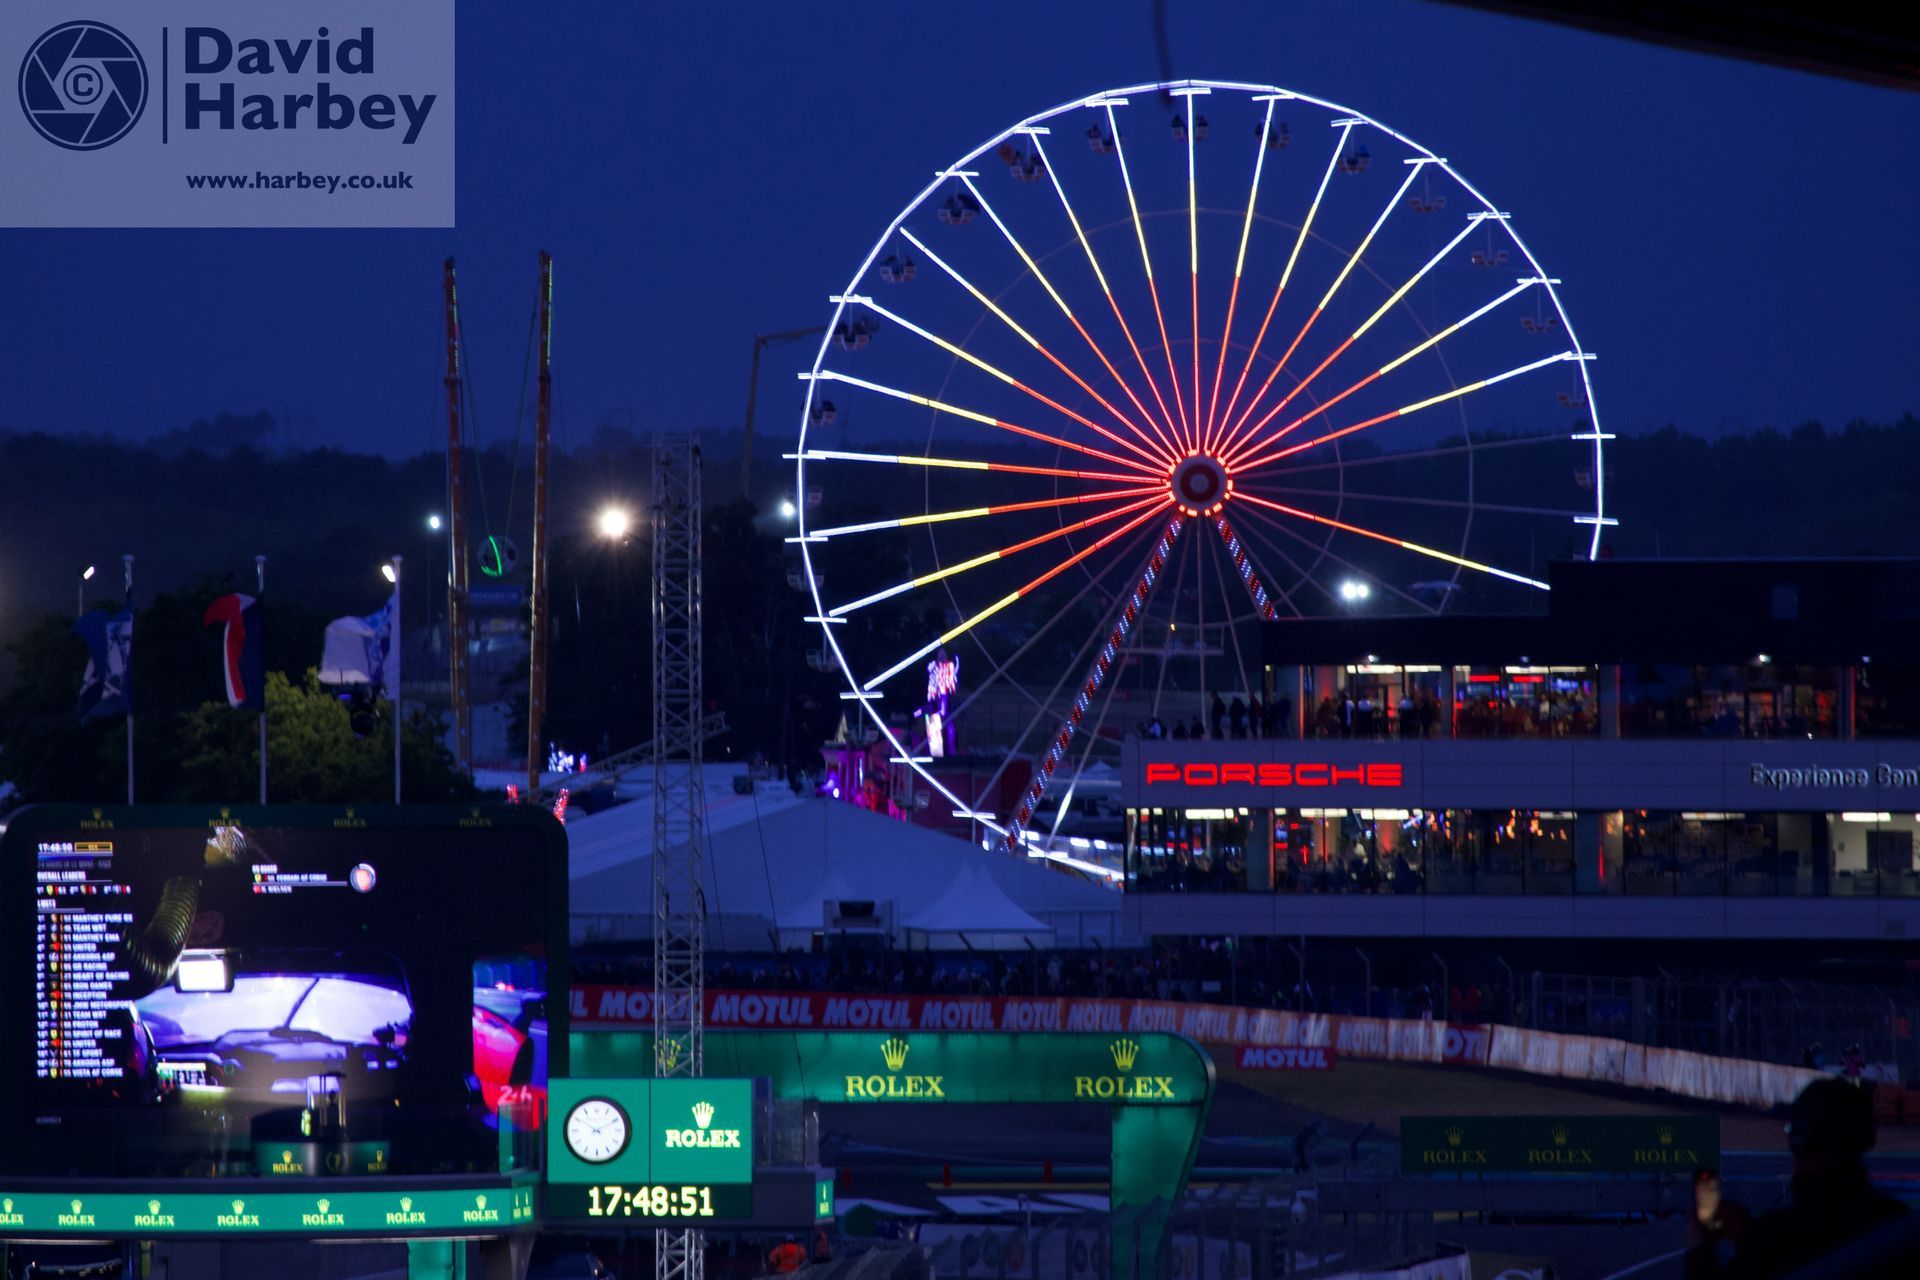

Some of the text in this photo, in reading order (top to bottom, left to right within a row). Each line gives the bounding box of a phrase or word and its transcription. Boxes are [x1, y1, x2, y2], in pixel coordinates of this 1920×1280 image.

[1146, 763, 1403, 787] PORSCHE
[1751, 763, 1920, 791] Experience Cen
[711, 994, 814, 1025] MOTUL
[822, 997, 911, 1028] MOTUL
[920, 1001, 995, 1030] MOTUL
[1001, 1001, 1062, 1030] MOTUL
[1067, 1003, 1123, 1032] MOTUL
[1181, 1007, 1229, 1041] MOTUL
[1338, 1021, 1386, 1056] MOTUL
[1242, 1048, 1328, 1069] MOTUL
[845, 1075, 945, 1098] ROLEX
[1074, 1076, 1175, 1099] ROLEX
[665, 1129, 741, 1148] ROLEX
[1423, 1150, 1487, 1164] ROLEX
[1527, 1150, 1592, 1164] ROLEX
[1634, 1150, 1699, 1164] ROLEX
[272, 1163, 303, 1174] ROLEX
[588, 1186, 714, 1216] 17:48:51
[0, 1213, 24, 1225] OLEX
[58, 1214, 95, 1227] ROLEX
[134, 1214, 175, 1227] ROLEX
[217, 1214, 260, 1227] ROLEX
[302, 1213, 344, 1226] ROLEX
[386, 1211, 426, 1224] ROLEX
[463, 1210, 499, 1222] ROLEX
